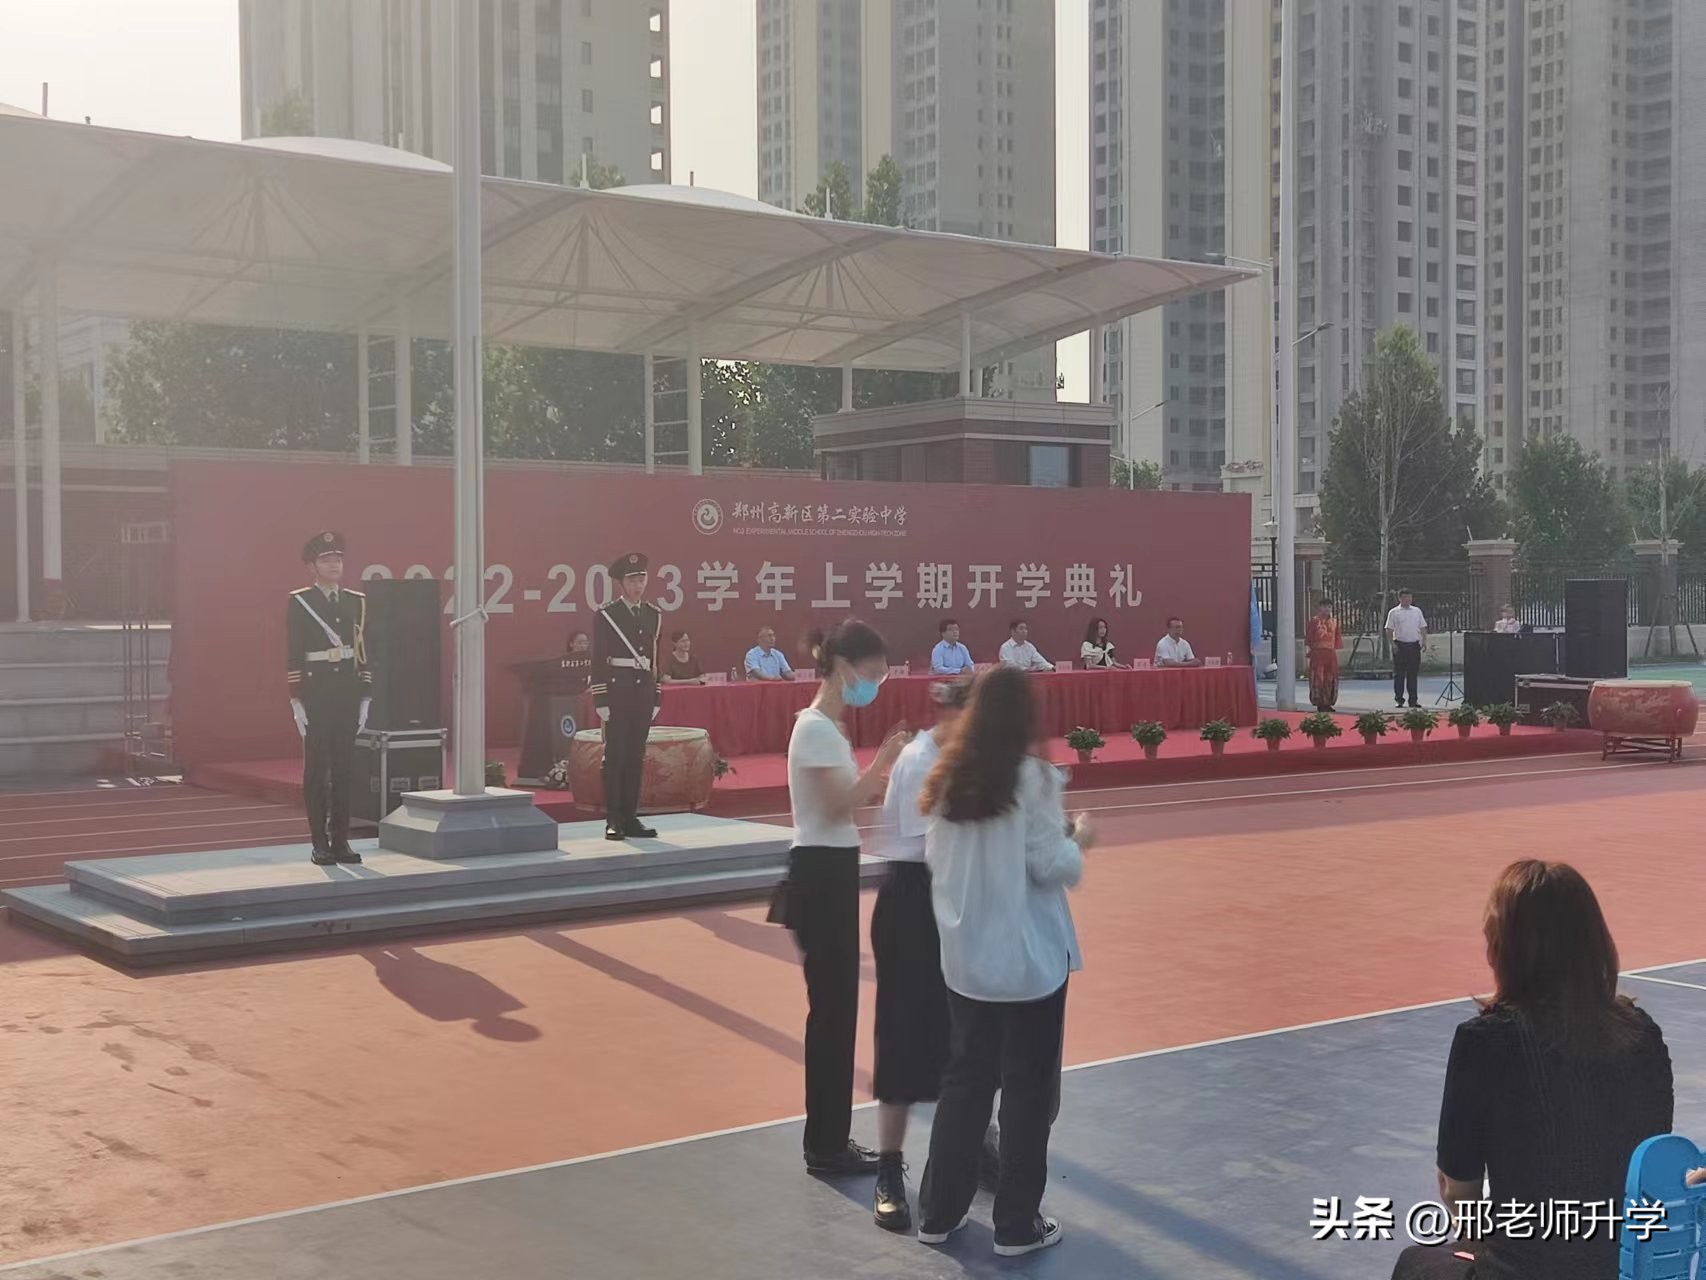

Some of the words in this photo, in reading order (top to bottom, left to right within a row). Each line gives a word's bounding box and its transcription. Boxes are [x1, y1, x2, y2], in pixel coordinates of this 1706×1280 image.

[732, 501, 907, 525] 郑州高新区第二实验中学
[361, 560, 1144, 614] 2-203学年上学期开学典礼
